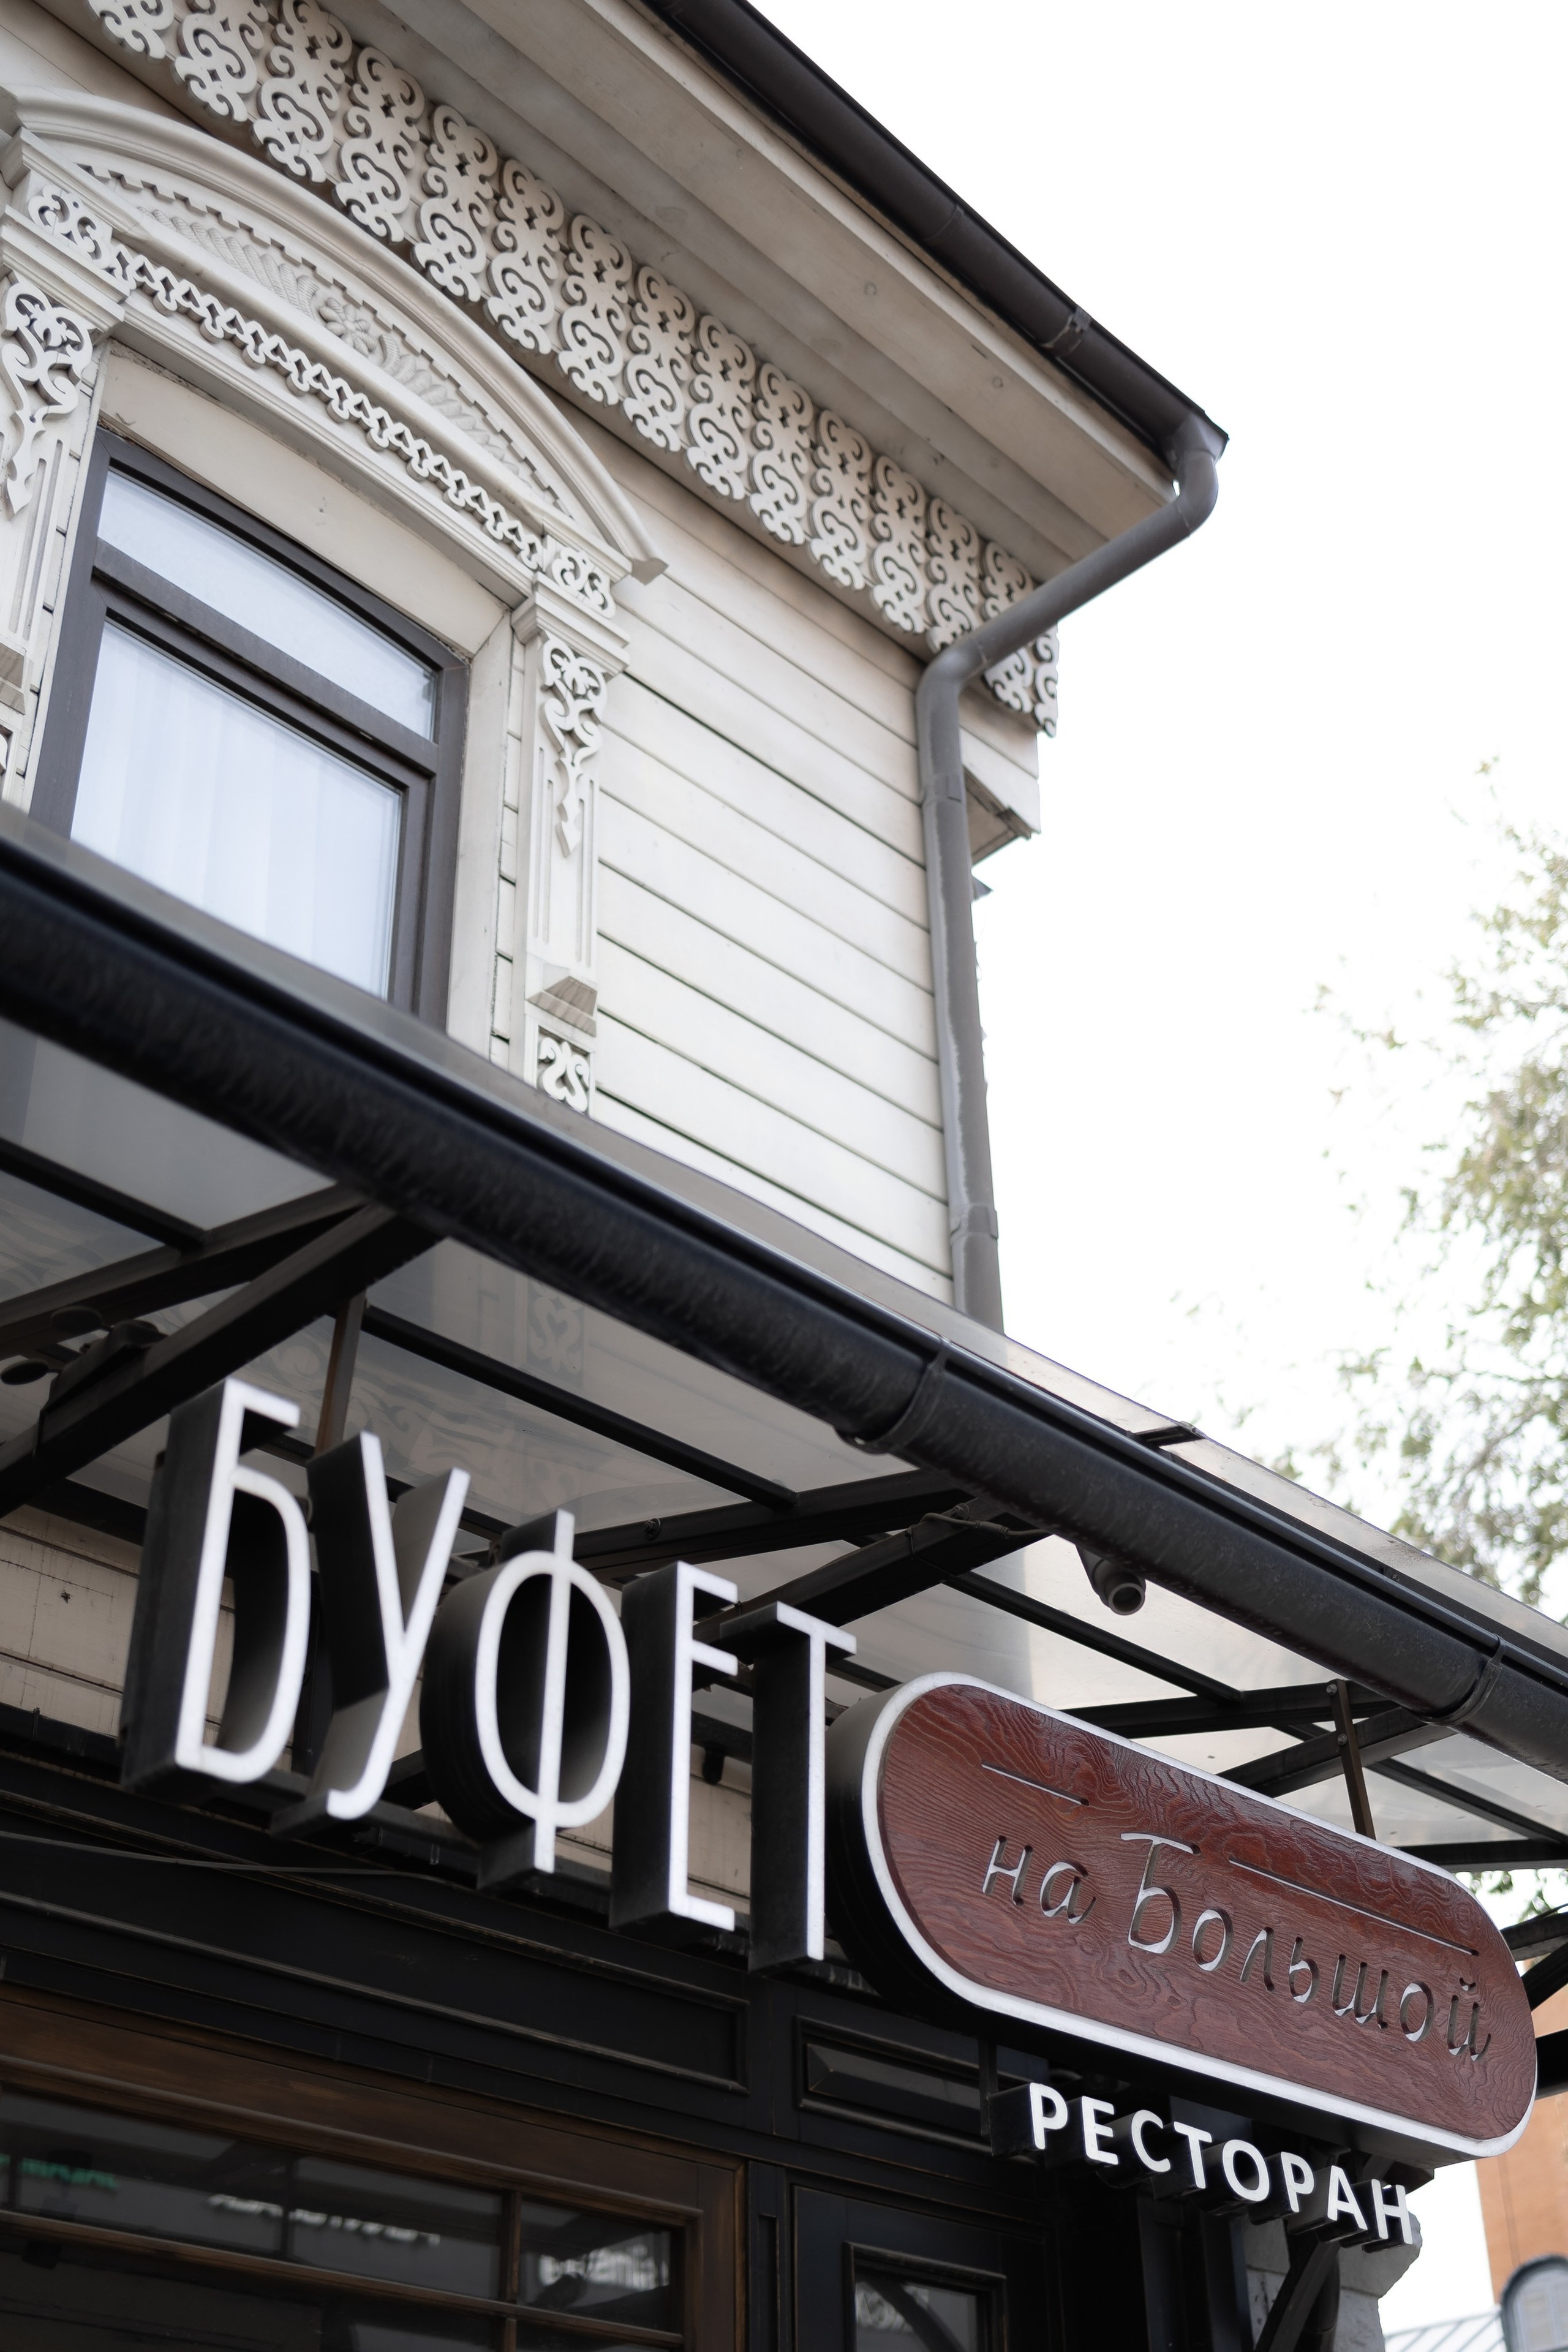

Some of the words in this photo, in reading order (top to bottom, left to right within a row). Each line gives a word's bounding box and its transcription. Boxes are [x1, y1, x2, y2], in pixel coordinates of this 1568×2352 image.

[175, 1379, 858, 1961] БУФЕТ
[982, 1836, 1096, 1924] на
[1121, 1833, 1492, 2062] Большой
[1030, 2084, 1414, 2245] РЕСТОРАН
